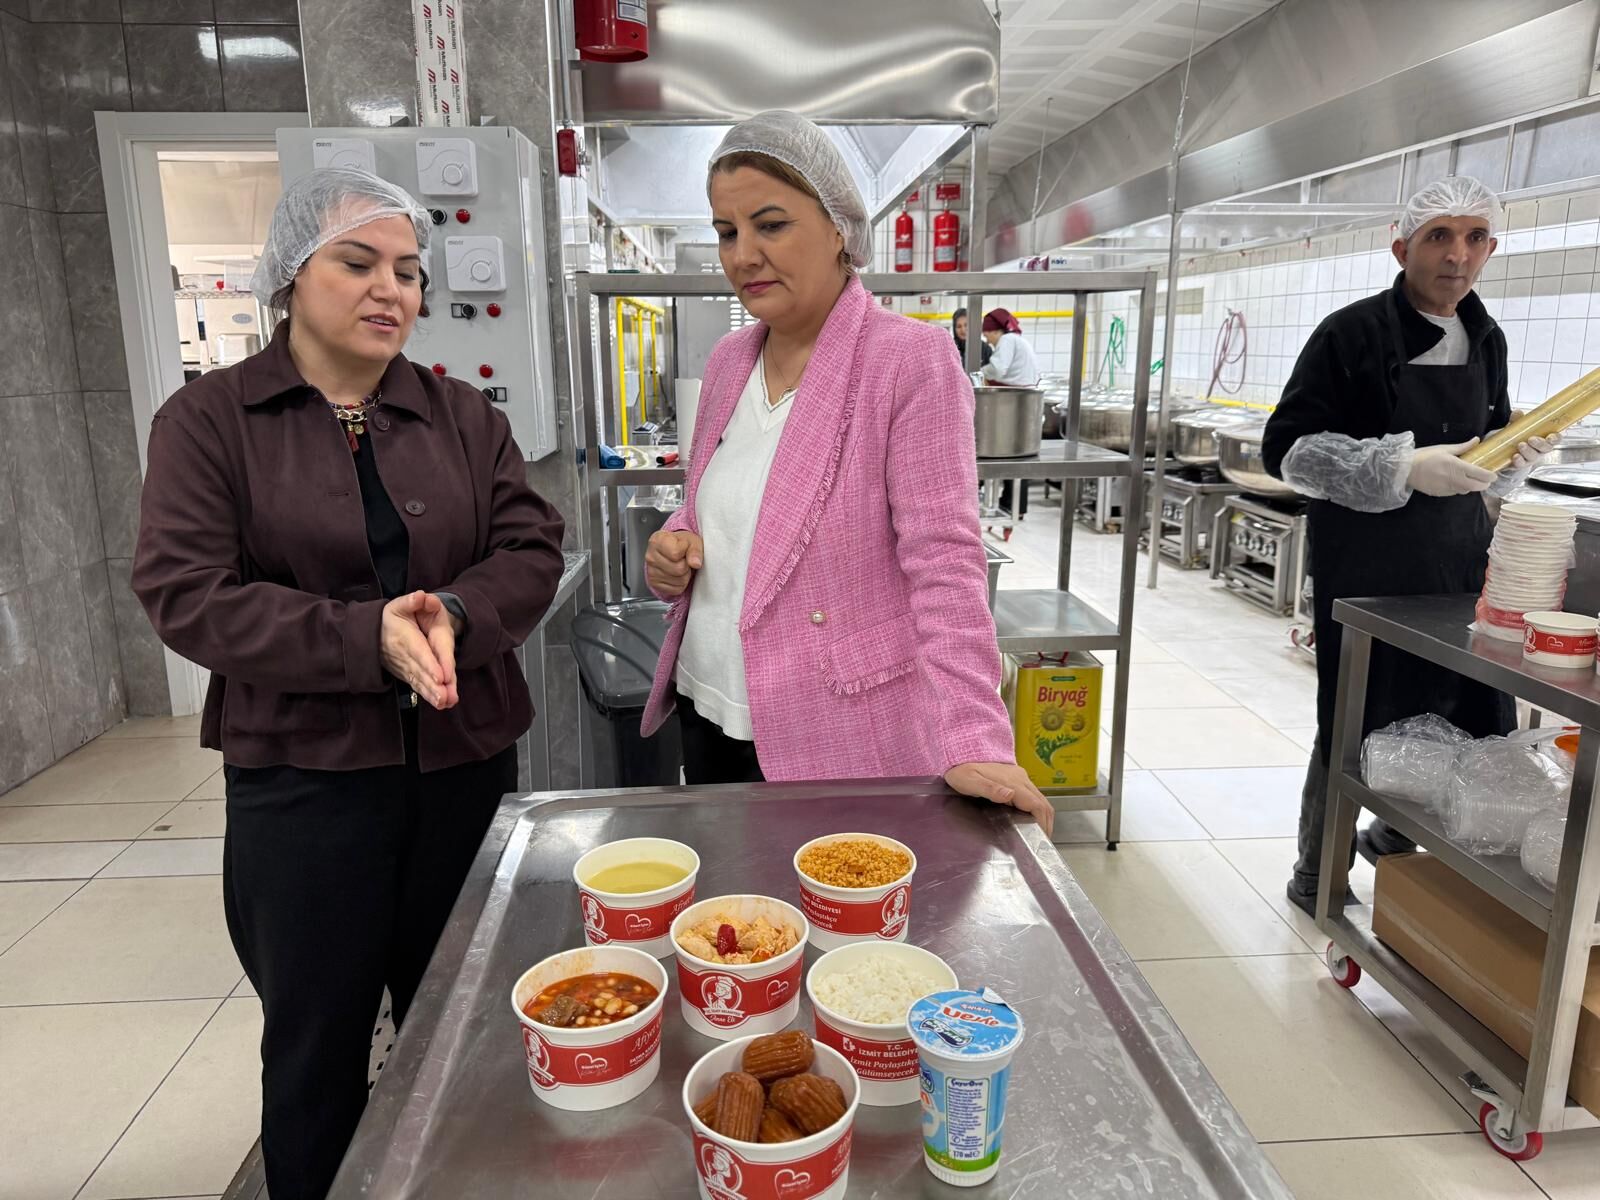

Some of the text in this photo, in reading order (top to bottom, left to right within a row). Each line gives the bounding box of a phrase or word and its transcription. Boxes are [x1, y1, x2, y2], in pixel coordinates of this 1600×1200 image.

[1037, 684, 1088, 708] Biryağ
[943, 1006, 1000, 1026] ayran
[858, 1048, 882, 1058] İZMİT
[850, 1056, 872, 1068] İzmit
[856, 1067, 915, 1079] Gülümseyecek
